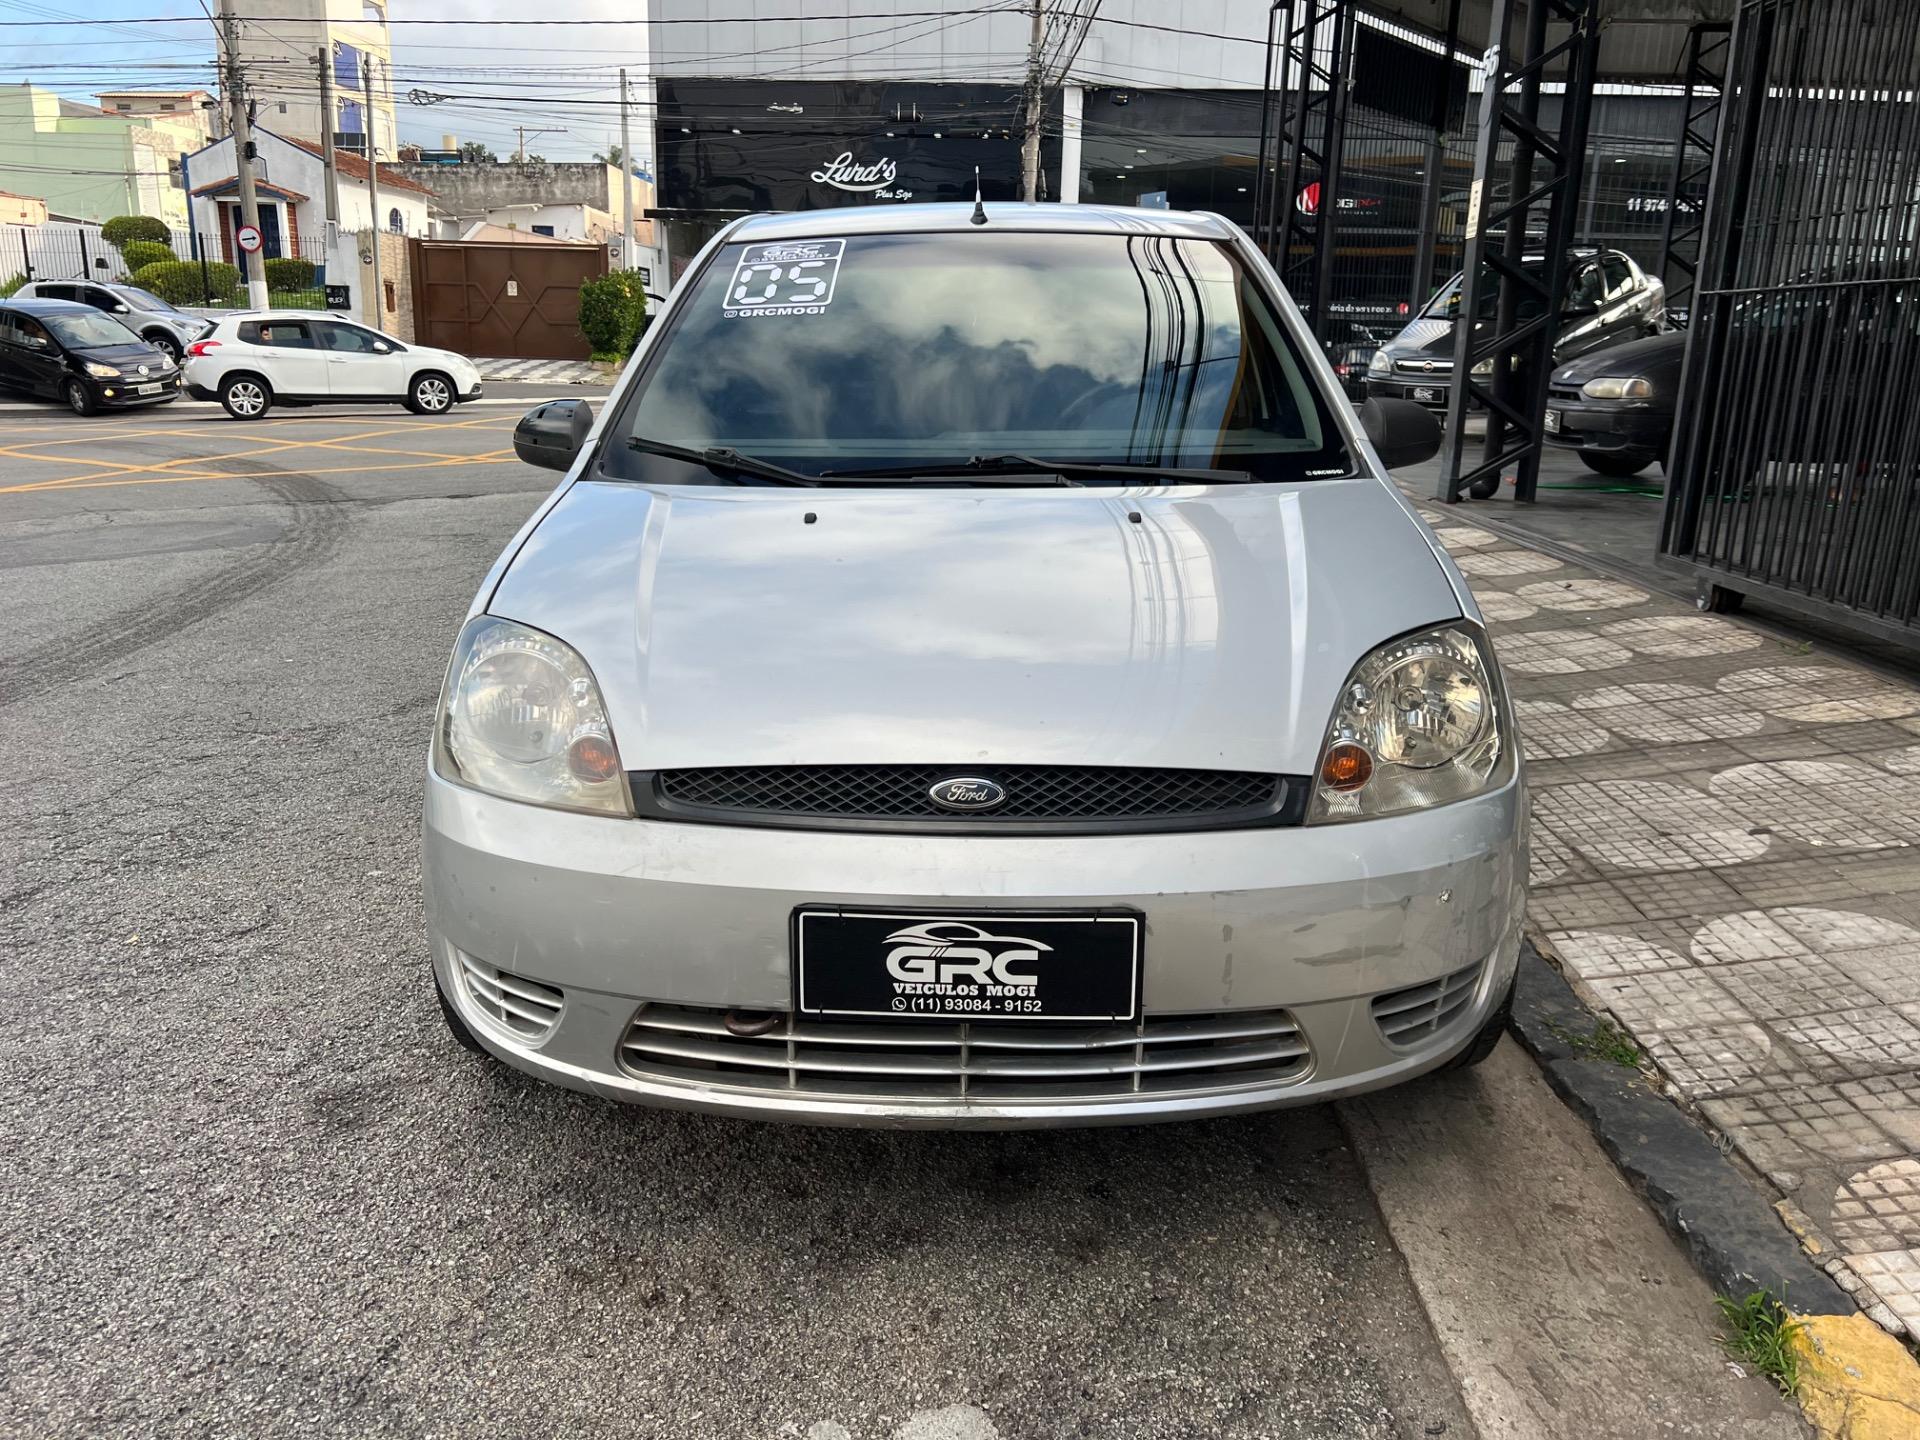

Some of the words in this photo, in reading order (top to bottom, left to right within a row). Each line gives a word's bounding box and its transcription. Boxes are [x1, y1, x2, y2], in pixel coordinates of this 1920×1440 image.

[811, 152, 897, 191] Lurd's
[875, 189, 894, 199] Plus
[734, 261, 827, 304] 05
[947, 783, 988, 801] Ford
[886, 946, 1039, 986] GRC
[893, 982, 979, 996] VEICULOS
[986, 985, 1036, 997] MOGI
[911, 997, 941, 1013] (11)
[945, 998, 992, 1012] 93084
[1004, 1000, 1042, 1012] 9152
